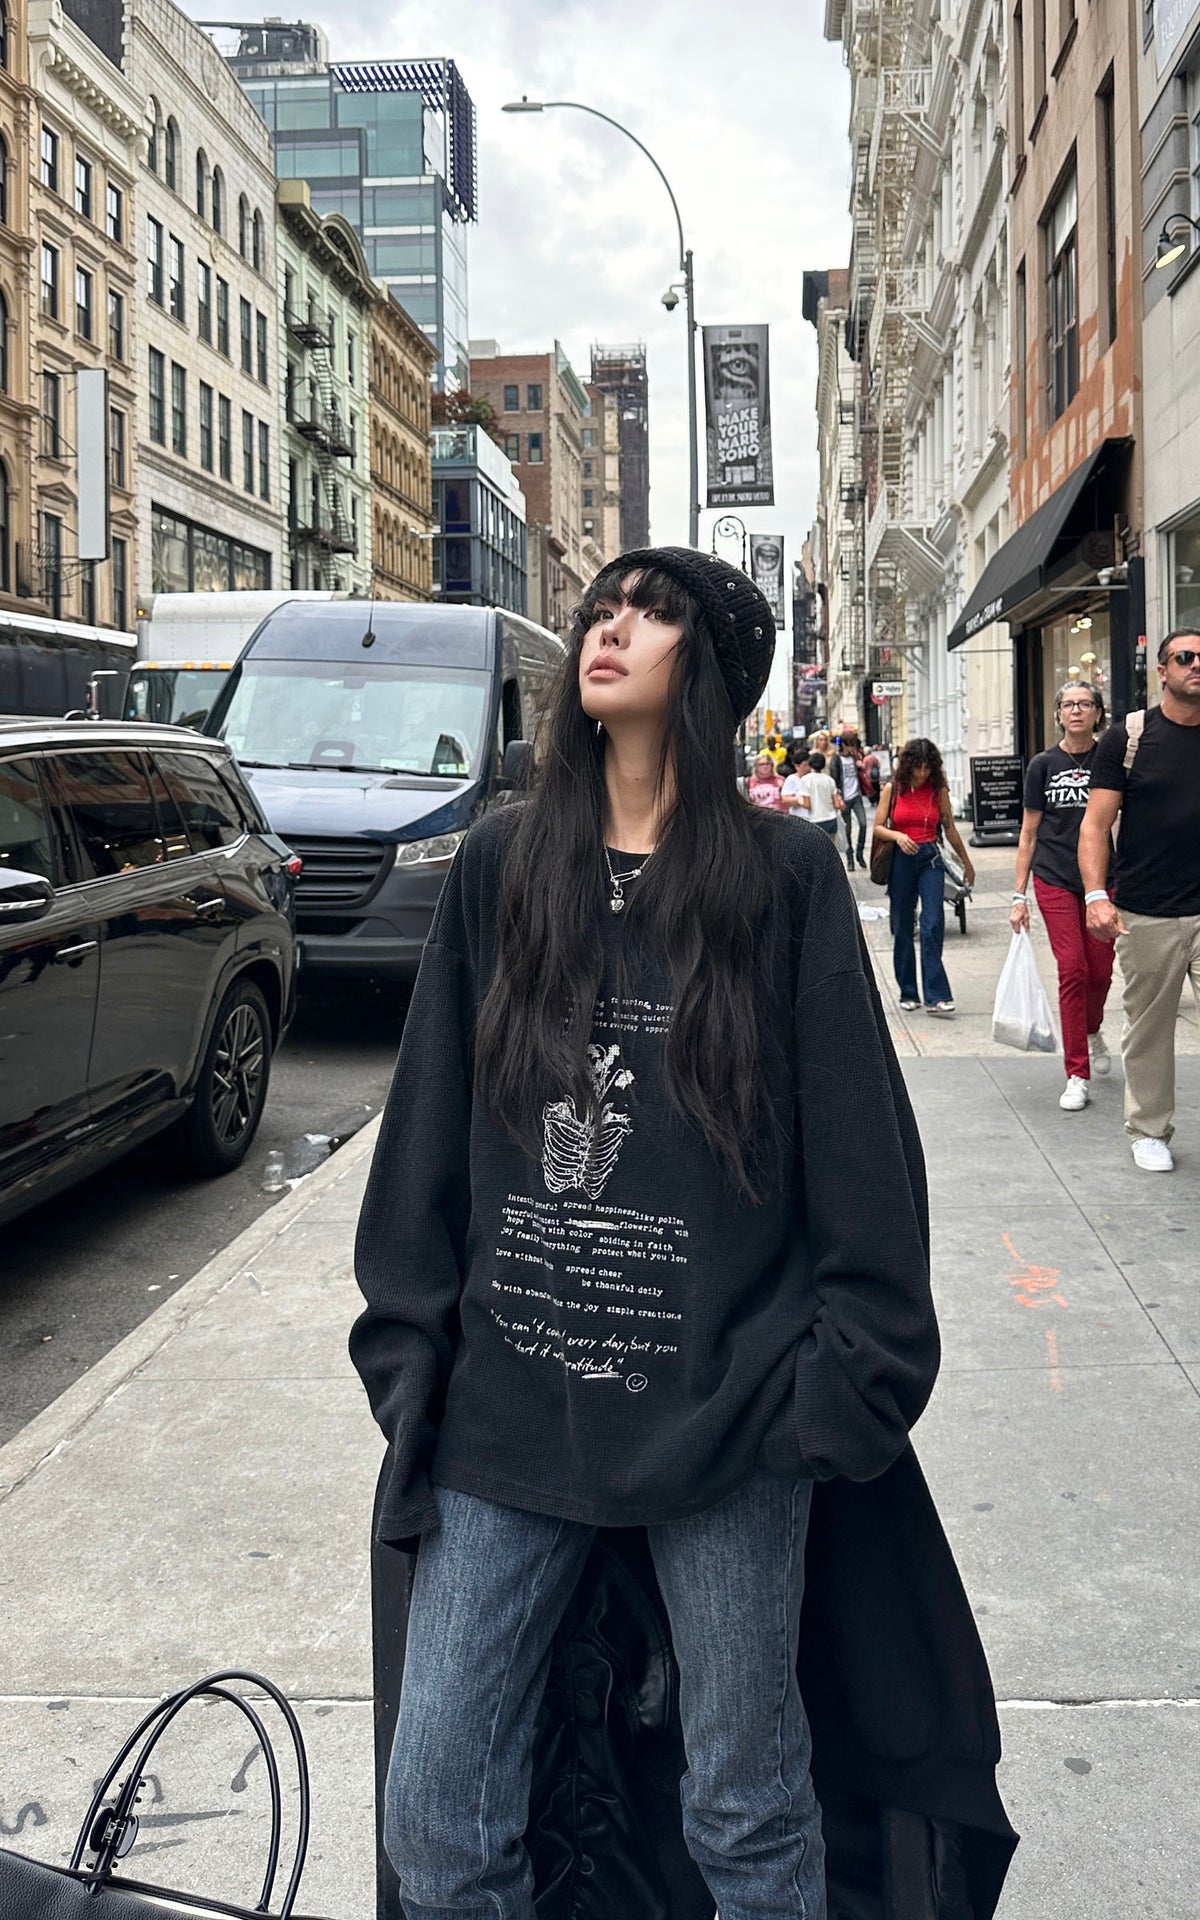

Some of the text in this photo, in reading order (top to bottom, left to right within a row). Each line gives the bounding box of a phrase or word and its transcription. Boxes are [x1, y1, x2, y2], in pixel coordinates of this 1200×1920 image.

[717, 407, 758, 427] MAKE
[719, 420, 758, 439] YOUR
[717, 431, 759, 450] MARK
[718, 444, 759, 463] SOHO
[563, 1201, 592, 1211] spread
[595, 1204, 636, 1216] happiness
[635, 1212, 655, 1222] like
[658, 1216, 684, 1226] pollen
[506, 1215, 524, 1225] hope
[548, 1226, 566, 1236] with
[569, 1229, 593, 1239] color
[599, 1236, 631, 1248] abiding
[634, 1240, 643, 1248] in
[648, 1242, 673, 1252] faith
[619, 1221, 664, 1235] flowering
[496, 1247, 512, 1256] love
[565, 1265, 595, 1275] spread
[598, 1268, 623, 1278] cheer
[592, 1247, 624, 1258] protect
[627, 1250, 647, 1259] what
[650, 1253, 667, 1261] you
[581, 1279, 663, 1298] be thankful daily
[584, 1302, 599, 1312] joy
[606, 1306, 634, 1316] simple
[512, 1317, 545, 1334] can't
[567, 1337, 597, 1349] every
[630, 1336, 651, 1351] but
[654, 1343, 678, 1354] you
[512, 1340, 539, 1356] tart
